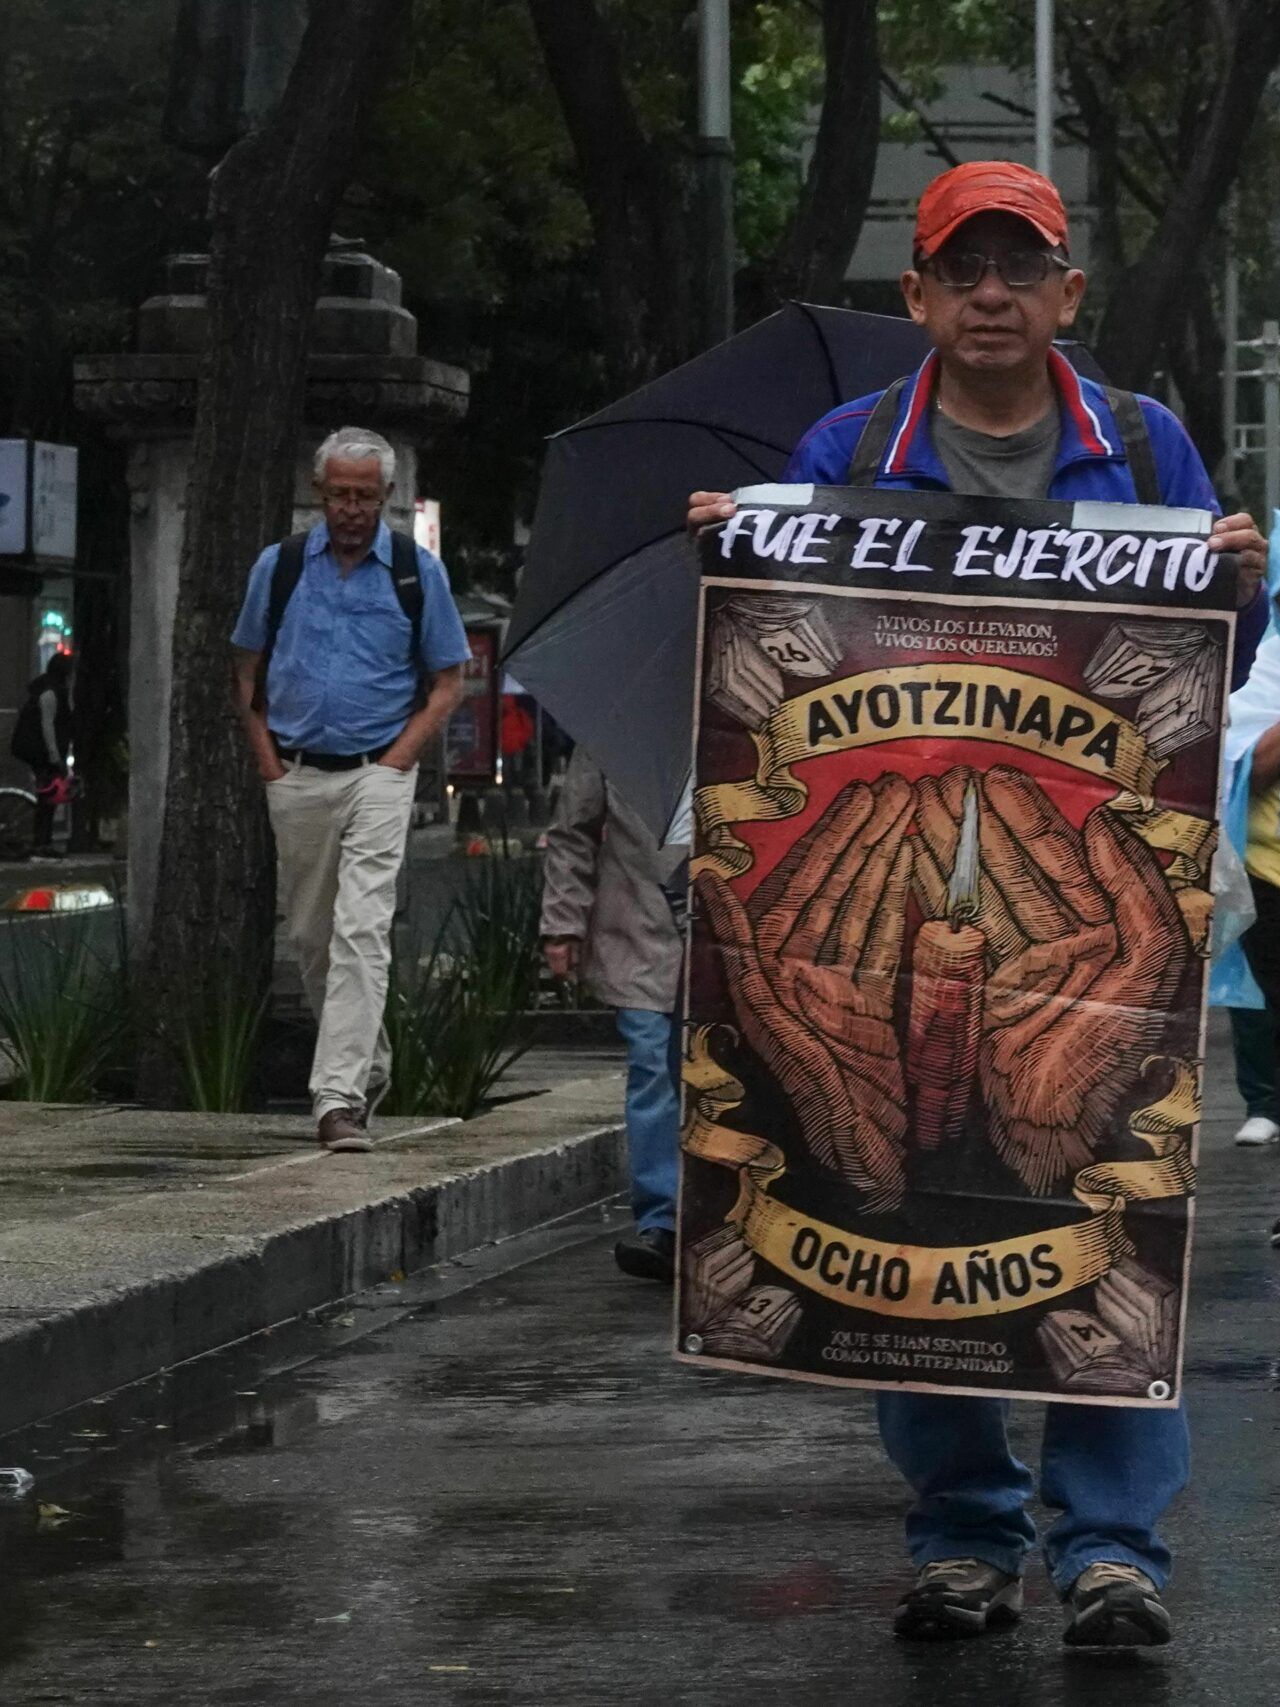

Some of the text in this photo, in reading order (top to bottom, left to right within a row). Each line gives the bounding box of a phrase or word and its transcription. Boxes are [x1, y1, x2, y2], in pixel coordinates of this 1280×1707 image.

[720, 510, 839, 563] FUE
[851, 517, 933, 572] EL
[877, 615, 1057, 641] ¡VIVOS LOS LLEVARON,
[767, 643, 810, 664] 26
[874, 632, 1058, 657] VIVOS LOS QUEREMOS!
[808, 682, 1119, 769] AYOTZINAPA
[791, 1226, 1063, 1305] OCHO AÑOS
[821, 1346, 871, 1363] COMO
[872, 1351, 910, 1366] UNA
[871, 1333, 891, 1348] SE
[893, 1334, 931, 1350] HAN
[932, 1337, 1007, 1356] SENTIDO
